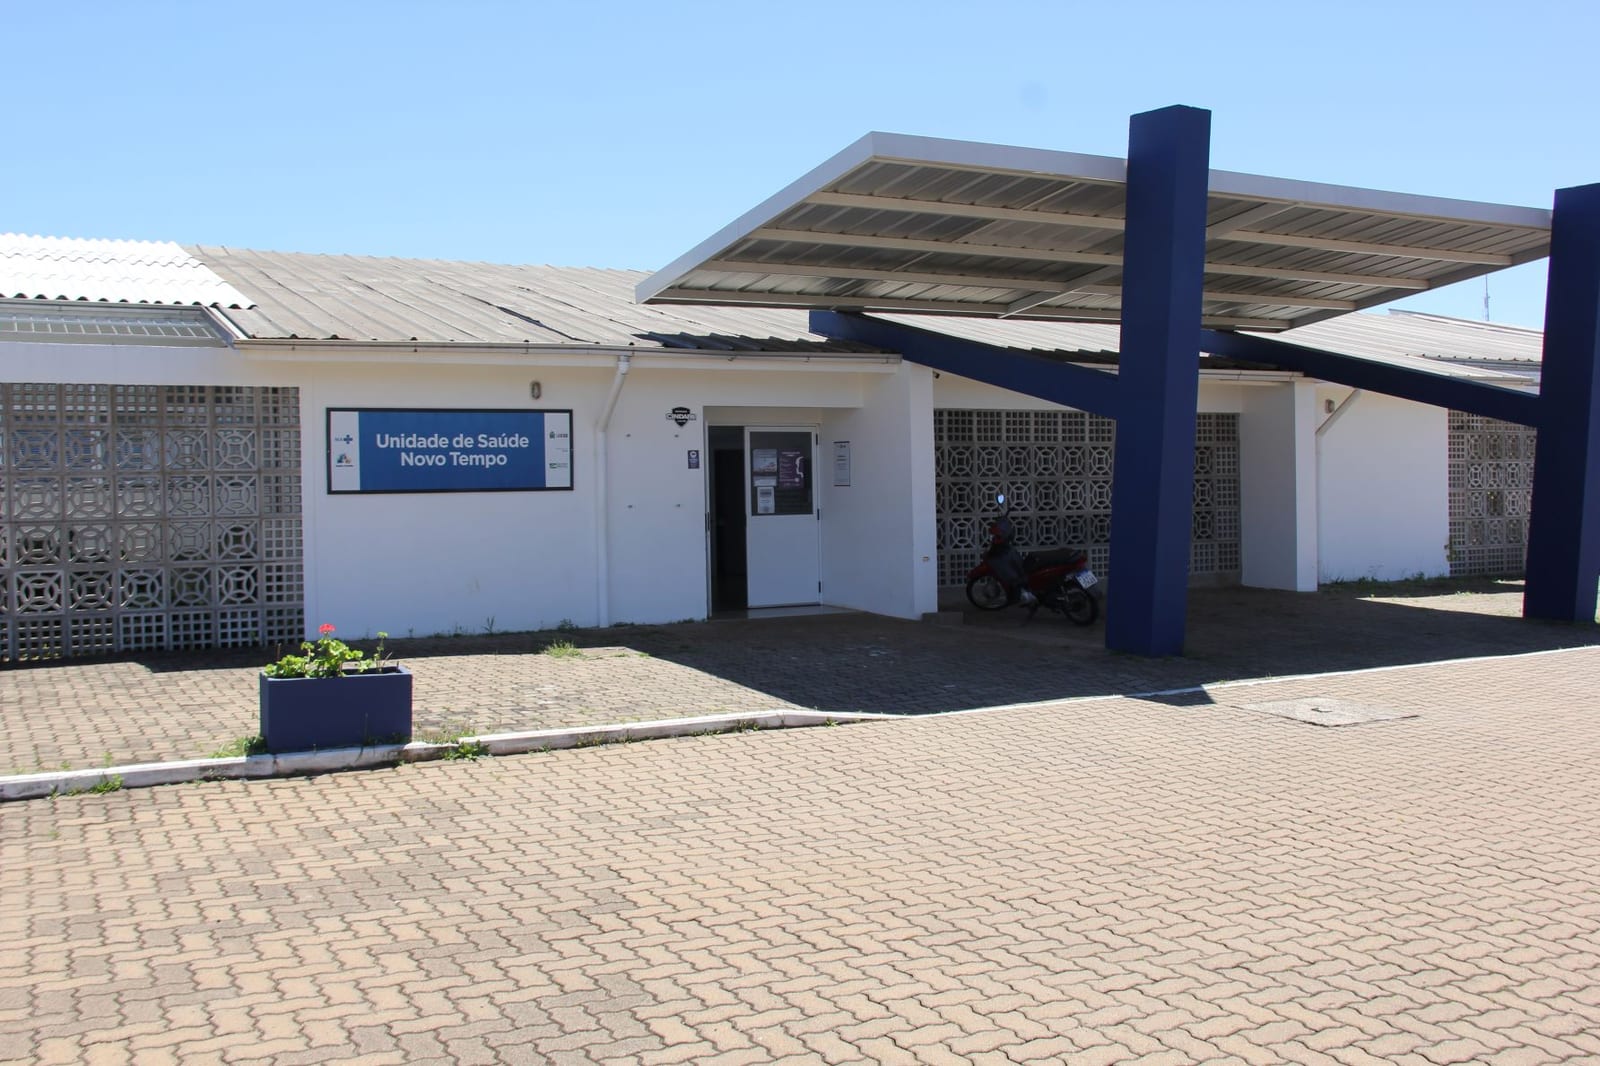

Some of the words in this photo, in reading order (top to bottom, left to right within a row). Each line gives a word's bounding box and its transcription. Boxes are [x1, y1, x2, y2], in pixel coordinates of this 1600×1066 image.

[376, 433, 449, 448] Unidade
[452, 433, 474, 448] de
[478, 433, 529, 448] Saúde
[400, 452, 447, 466] Novo
[449, 452, 508, 468] Tempo
